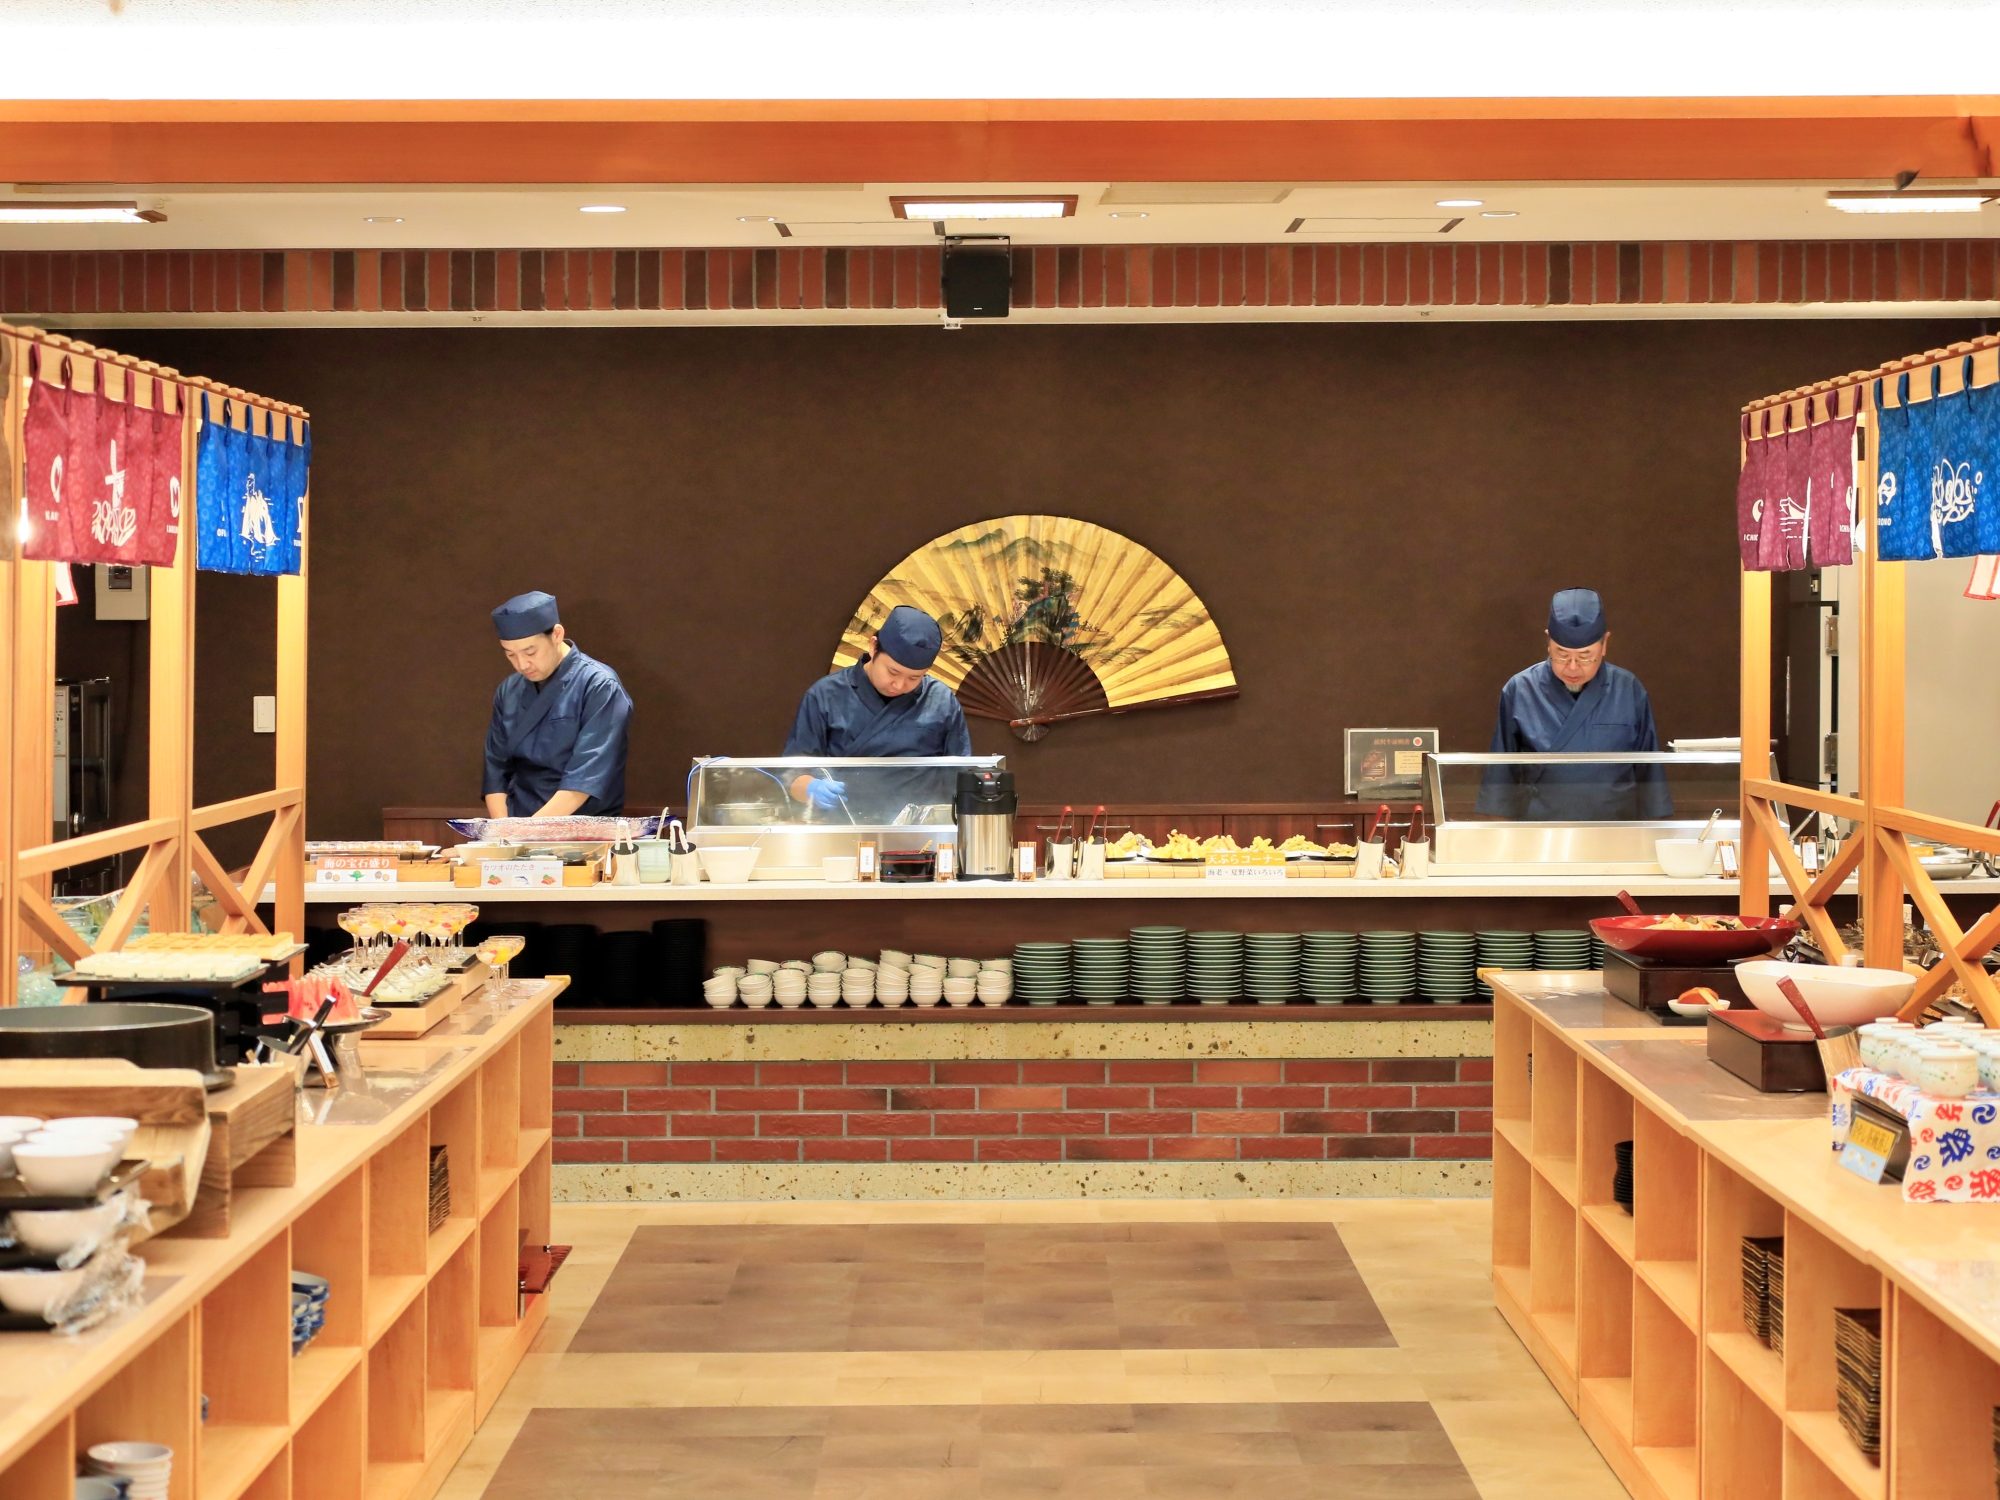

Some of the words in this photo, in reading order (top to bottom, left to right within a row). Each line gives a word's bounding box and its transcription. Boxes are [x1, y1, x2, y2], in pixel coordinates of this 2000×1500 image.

[324, 858, 390, 868] 海の宝石盛り
[1207, 854, 1284, 864] 天ぷらコーナー
[1936, 1128, 1975, 1167] 祭
